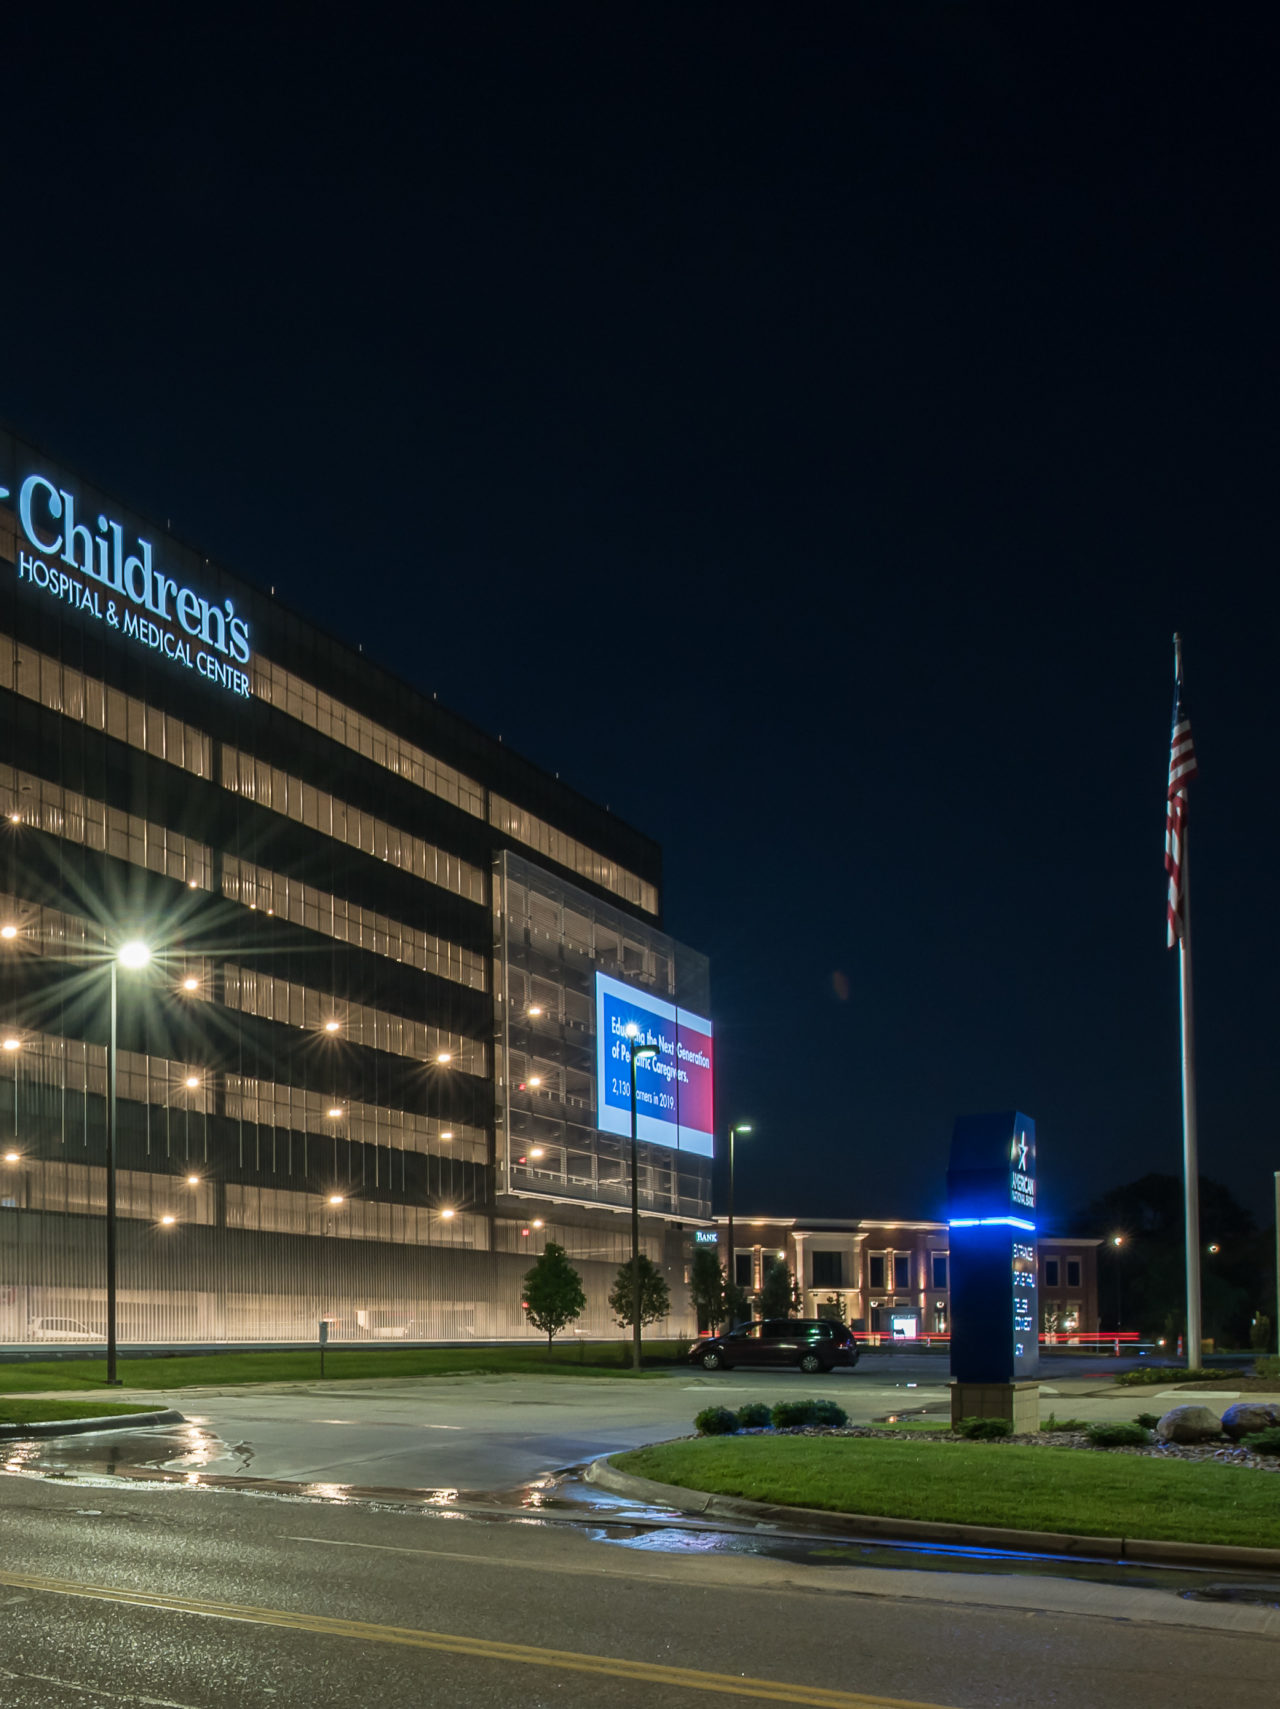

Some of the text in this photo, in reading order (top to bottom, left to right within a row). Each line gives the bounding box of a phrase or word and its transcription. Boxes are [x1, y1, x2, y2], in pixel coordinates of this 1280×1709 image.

[20, 474, 250, 664] Children's
[19, 551, 250, 698] HOSPITAL & MEDICAL CENTER
[612, 1040, 689, 1083] of Peatric Caregivers.
[658, 1034, 675, 1056] Next
[677, 1042, 710, 1069] Generation
[612, 1077, 631, 1097] 2,130
[636, 1090, 652, 1104] arners
[653, 1091, 659, 1106] in
